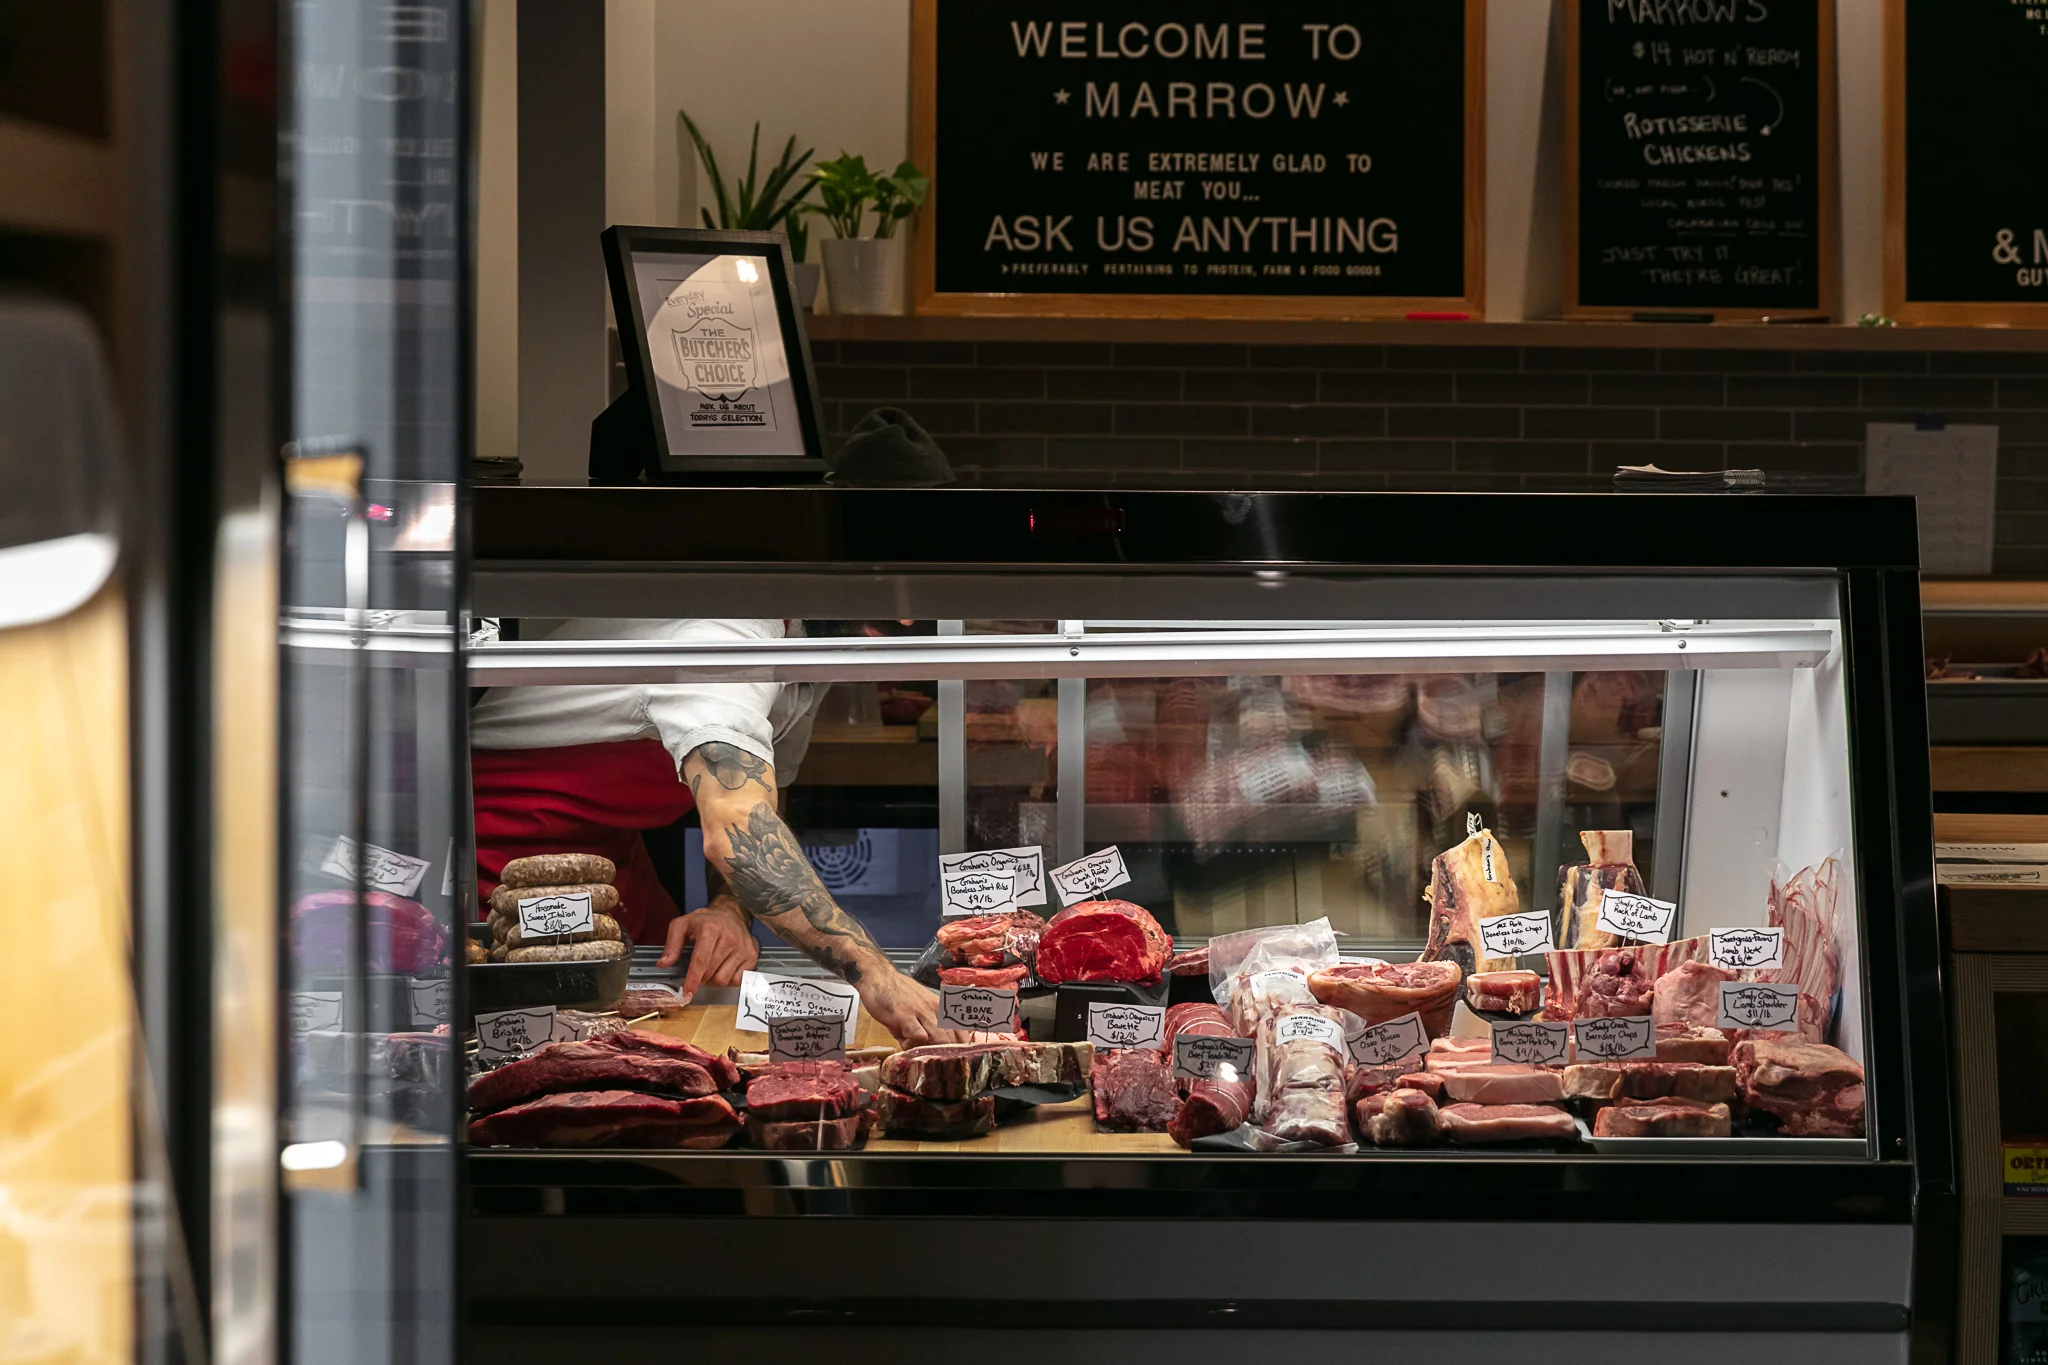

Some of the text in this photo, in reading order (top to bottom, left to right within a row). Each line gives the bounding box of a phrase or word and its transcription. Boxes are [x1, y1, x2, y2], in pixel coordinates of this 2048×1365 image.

[1011, 21, 1362, 61] WELCOME TO
[1632, 39, 1673, 67] $14
[1682, 48, 1716, 67] HOT
[1746, 46, 1801, 70] READY
[1085, 82, 1326, 118] MARROW
[1623, 111, 1749, 140] ROTISSERIE
[1643, 141, 1752, 166] CHICKENS
[1030, 151, 1372, 173] WE ARE EXTREMELY GLAD TO
[1134, 180, 1260, 201] MEAT YOU...
[984, 215, 1399, 254] ASK US ANYTHING
[1992, 228, 2022, 265] &
[1601, 244, 1659, 264] JUST
[1664, 243, 1704, 263] TRY
[1012, 263, 1089, 275] PREFERABLY
[1103, 264, 1174, 275] PERTAINING
[1183, 264, 1199, 275] TO
[1263, 264, 1292, 275] FARM
[666, 290, 704, 308] Everyday
[687, 301, 735, 319] Special
[700, 329, 725, 337] THE
[695, 363, 746, 383] CHOICE
[700, 403, 756, 411] ASK US ABOUT
[721, 414, 763, 422] SELECTION
[991, 856, 1019, 870] Organics
[951, 882, 1009, 894] Boneless Short Ribs
[547, 911, 576, 920] Italian
[1614, 904, 1657, 921] Rack of Lamb
[1525, 926, 1543, 934] Chops
[1722, 946, 1739, 954] Lamb
[961, 993, 993, 1002] Graham's
[1758, 992, 1778, 1000] Creek
[755, 992, 844, 1015] Graham's Organics
[764, 1004, 781, 1012] 100%
[1733, 999, 1788, 1009] Lamb Shoulder
[494, 1016, 525, 1028] Graham's
[1102, 1012, 1155, 1024] Graham's Organics
[493, 1025, 527, 1038] Brisket
[1610, 1021, 1629, 1029] Creek
[1360, 1033, 1401, 1049] Osso Bucco
[1585, 1030, 1638, 1043] Barnsley Chops
[1187, 1050, 1205, 1059] Beef
